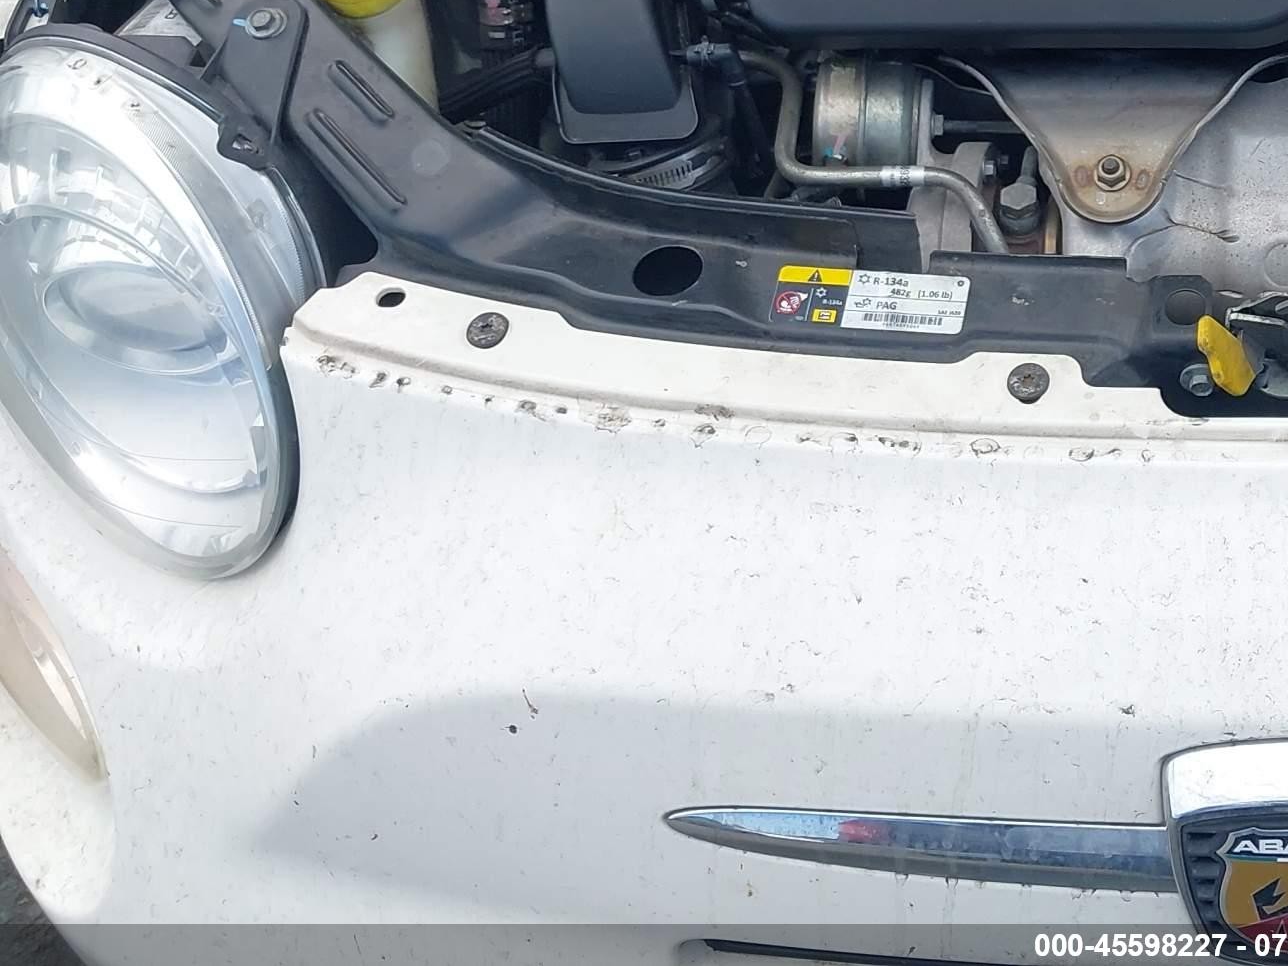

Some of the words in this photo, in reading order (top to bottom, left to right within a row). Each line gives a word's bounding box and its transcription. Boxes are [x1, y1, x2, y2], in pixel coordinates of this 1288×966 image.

[872, 277, 909, 288] R-134a
[890, 288, 912, 298] 482g
[917, 290, 940, 300] (1.06
[941, 290, 953, 300] lb)
[876, 301, 898, 310] PAG
